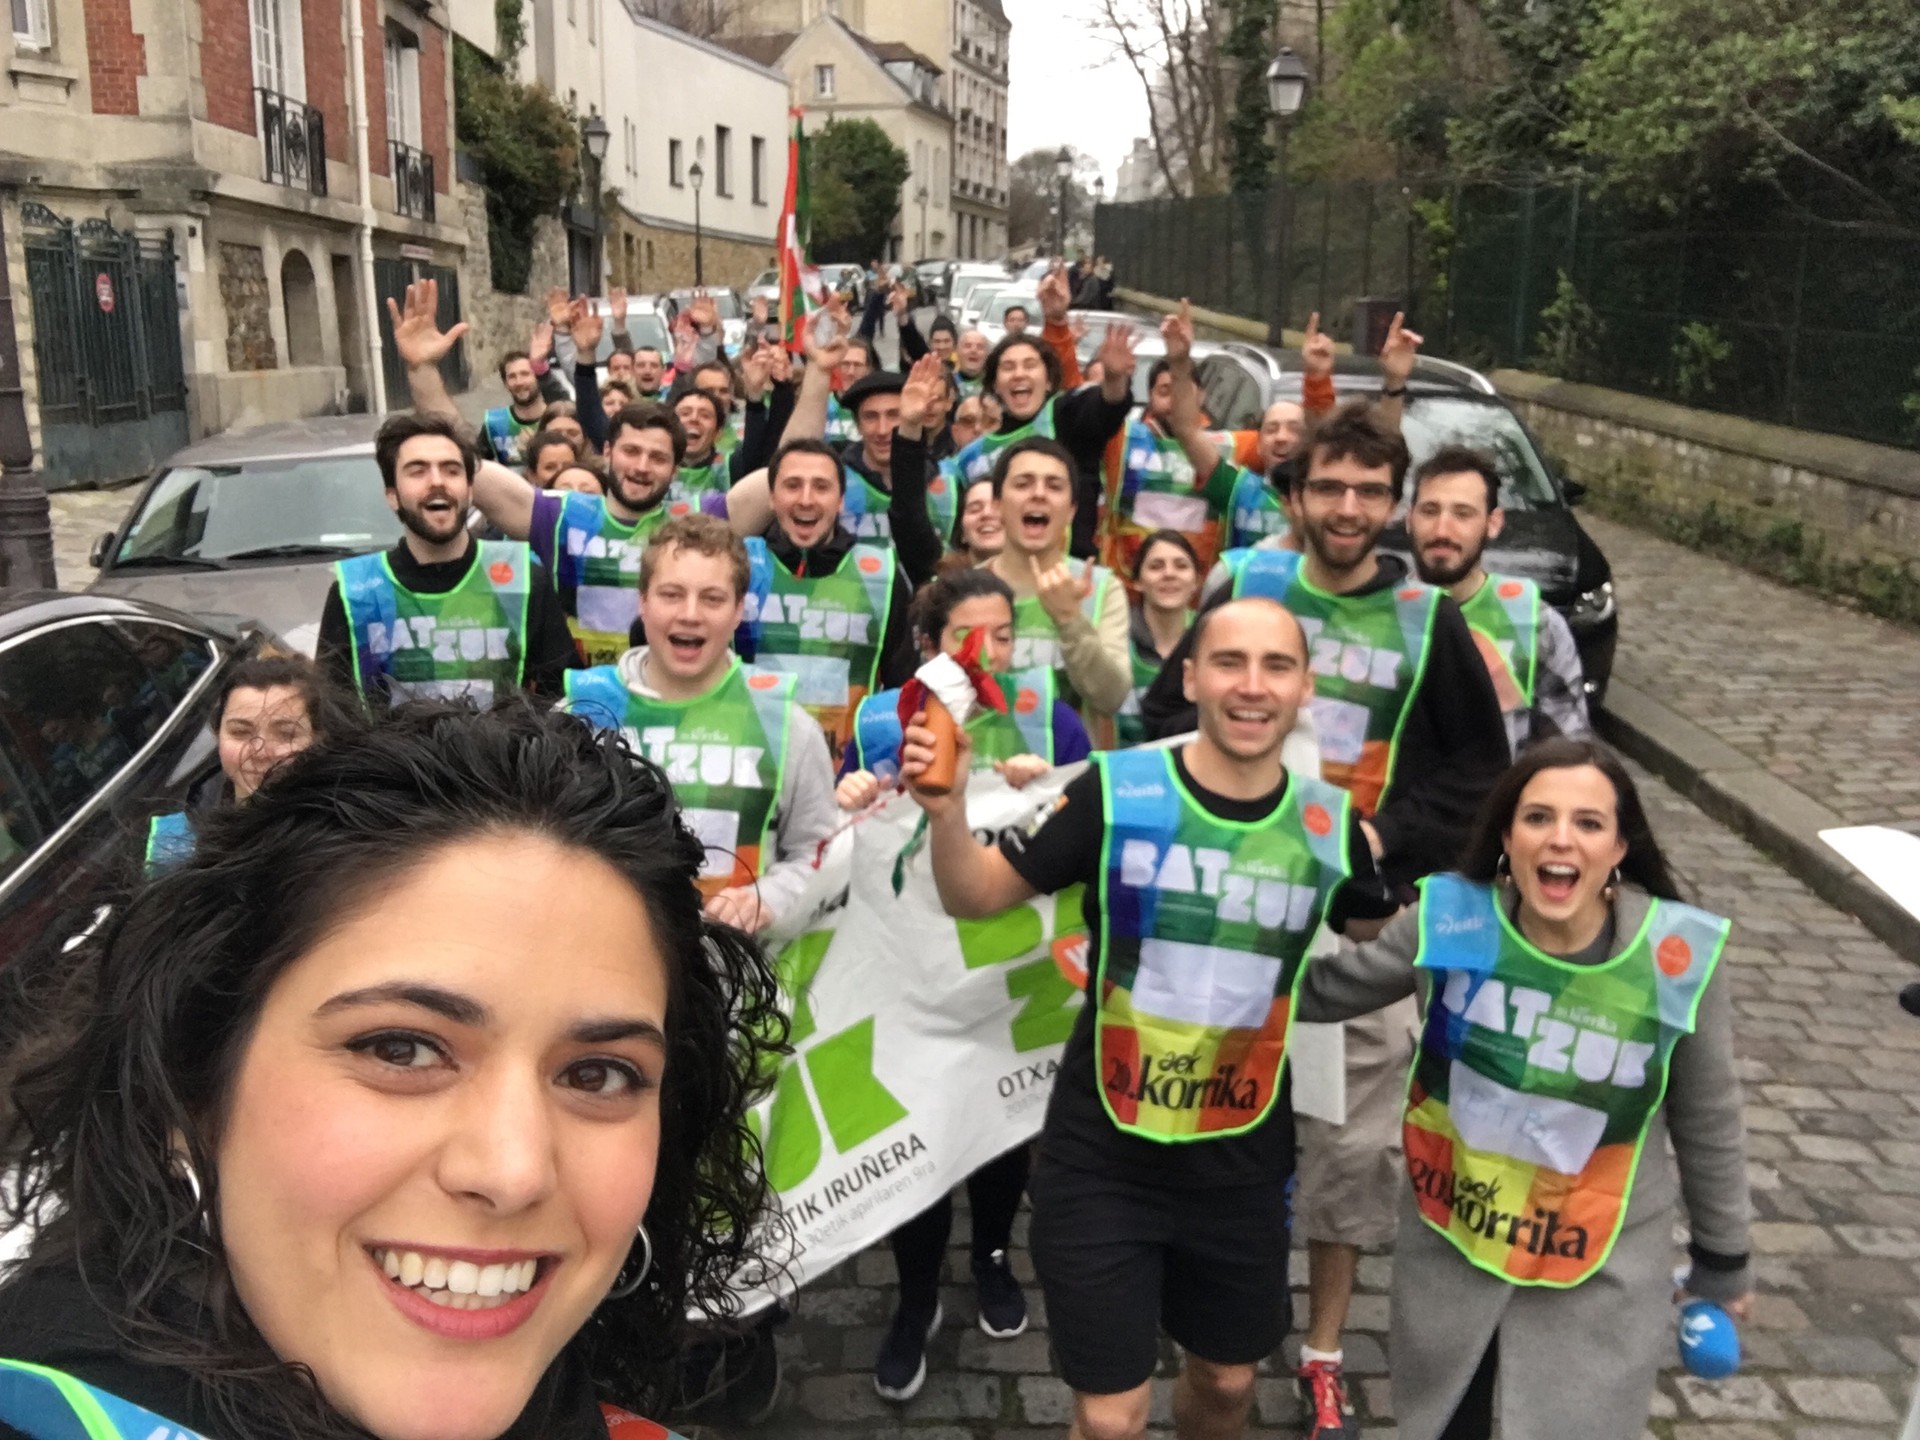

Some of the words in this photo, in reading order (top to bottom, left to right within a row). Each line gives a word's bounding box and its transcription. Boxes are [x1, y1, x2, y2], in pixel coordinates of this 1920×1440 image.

[743, 592, 808, 624] BAT
[800, 609, 872, 644] ZUK
[431, 627, 510, 662] ZUK
[1308, 637, 1403, 689] ZUK
[665, 743, 765, 788] ZUK
[1120, 838, 1230, 896] BAT
[1526, 1018, 1656, 1088] ZUK
[823, 1132, 928, 1208] IRUÑERA
[850, 1175, 913, 1224] apirilaren
